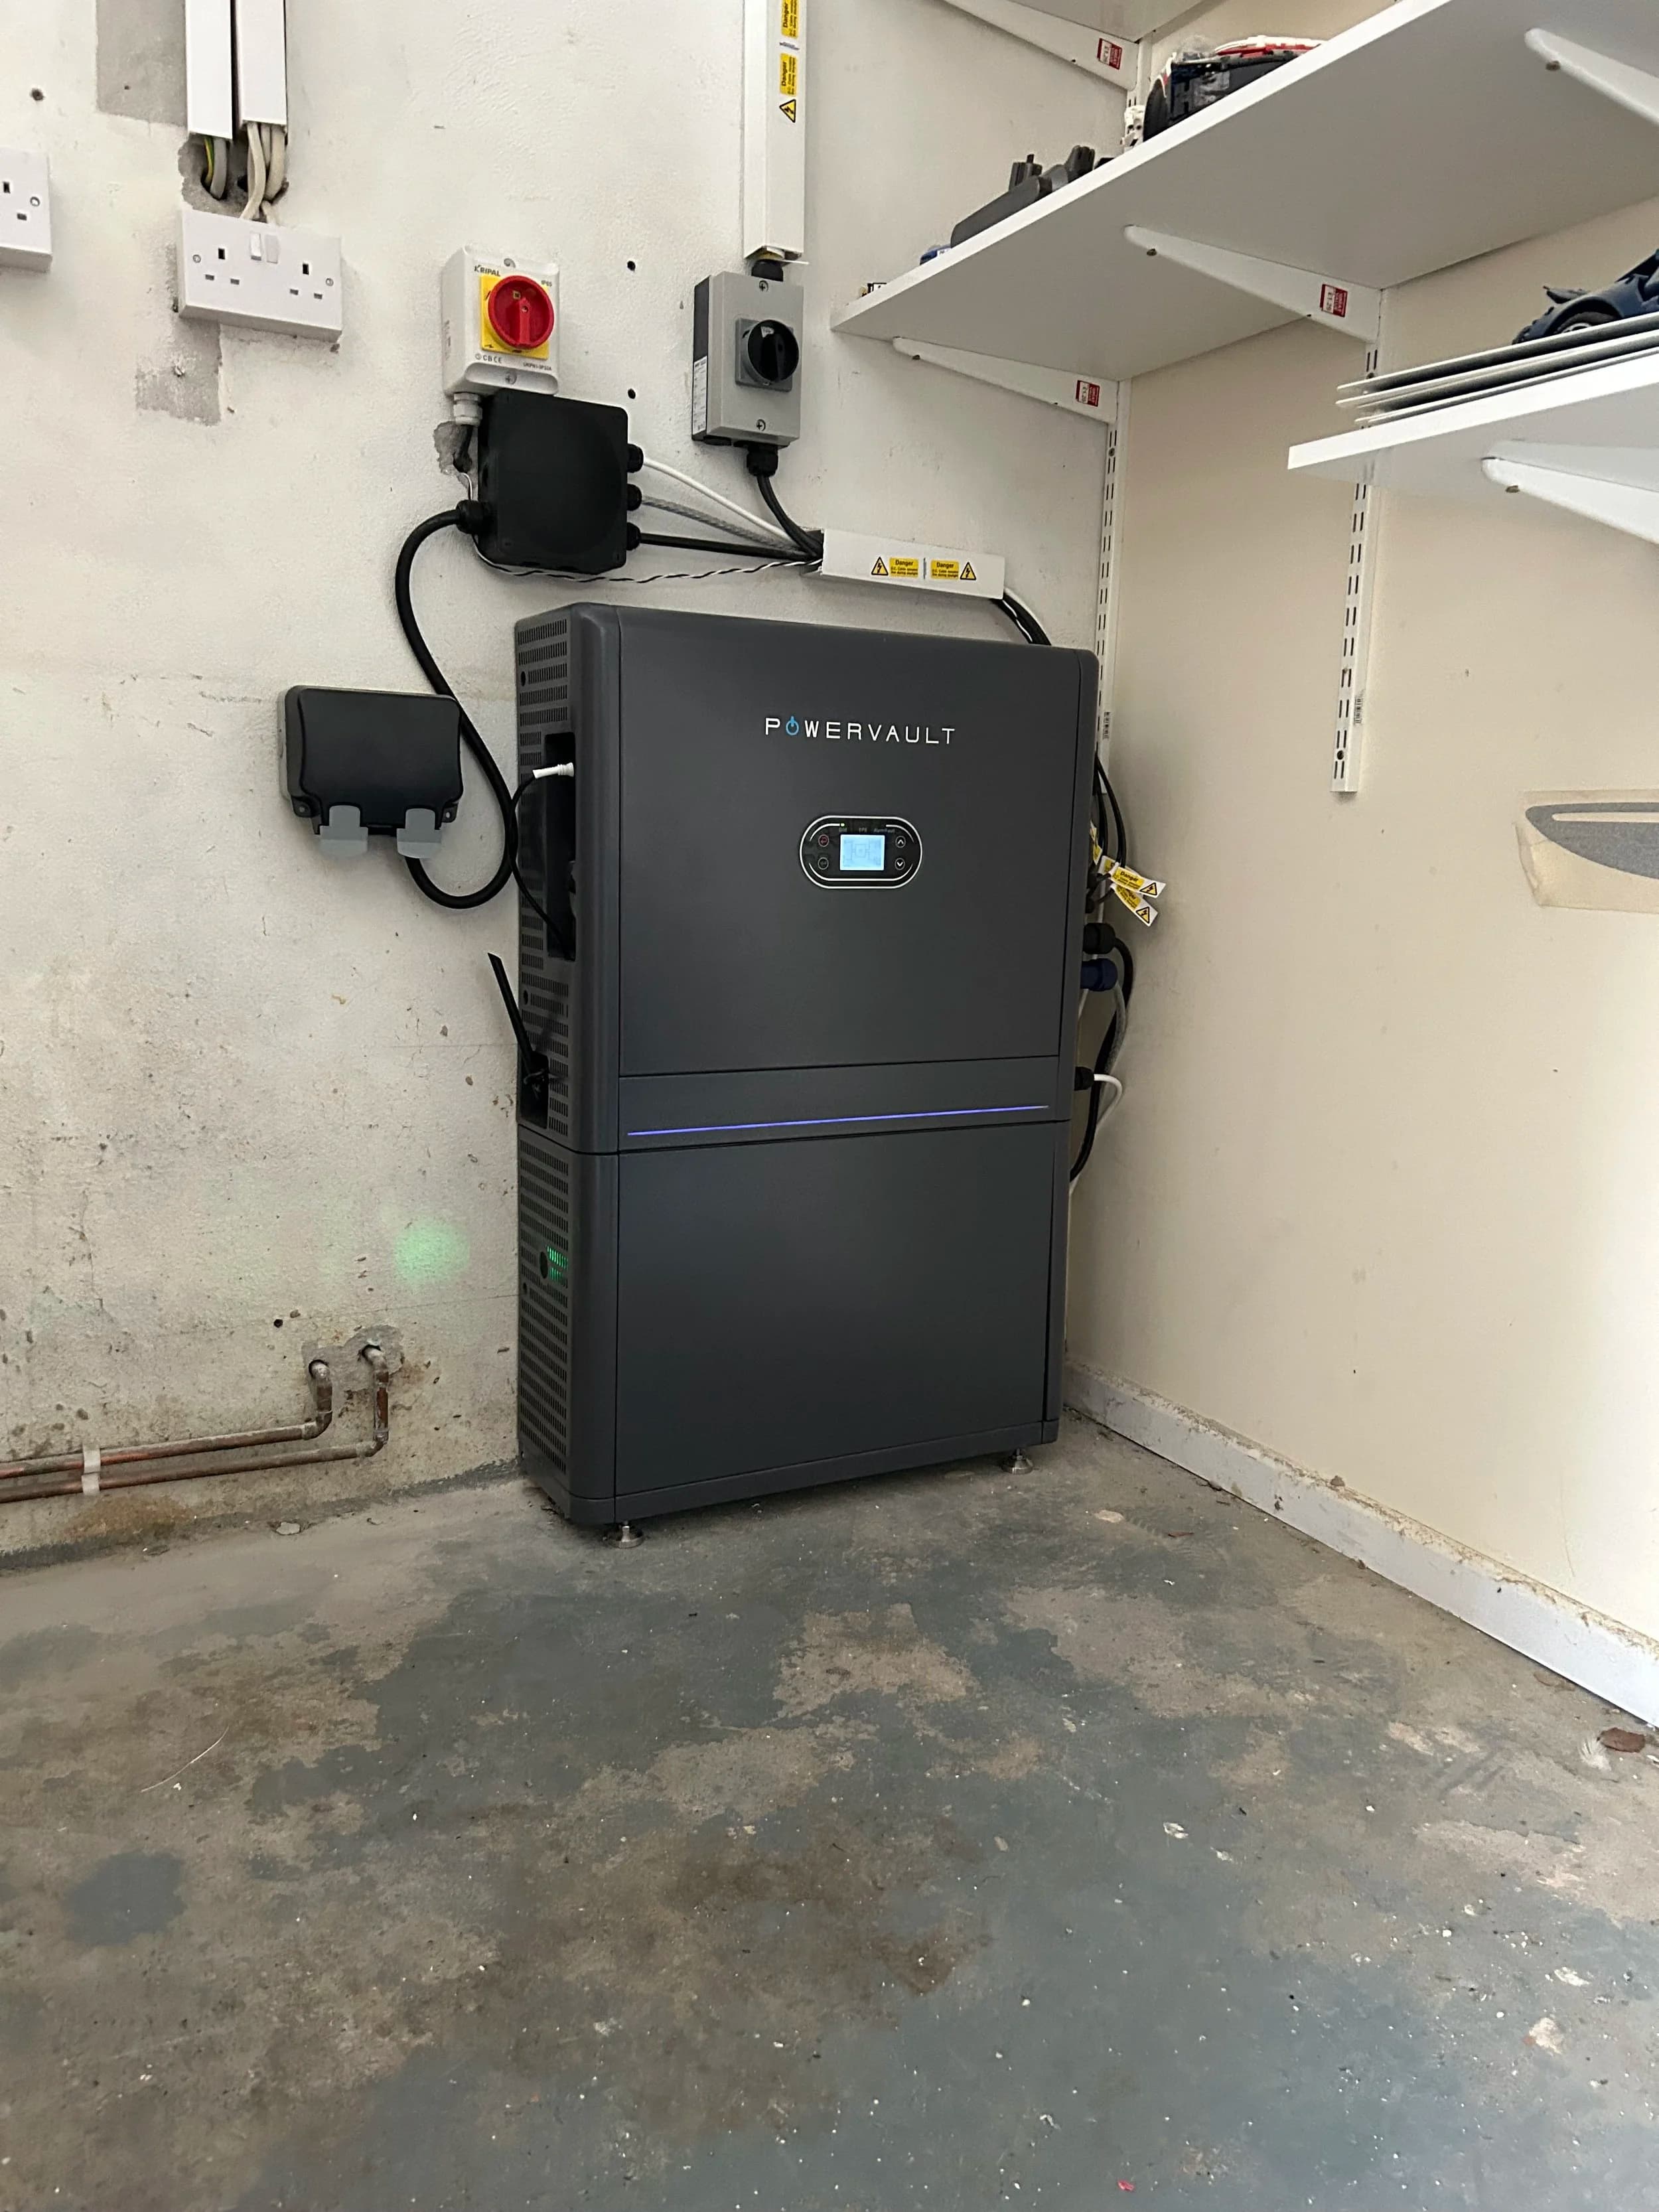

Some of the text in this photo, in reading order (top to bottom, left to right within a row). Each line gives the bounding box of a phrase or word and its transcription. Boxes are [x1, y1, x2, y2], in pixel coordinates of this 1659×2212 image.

[474, 265, 500, 277] KRIPAL
[765, 715, 955, 745] POWERVAULT
[1120, 871, 1139, 882] Danger
